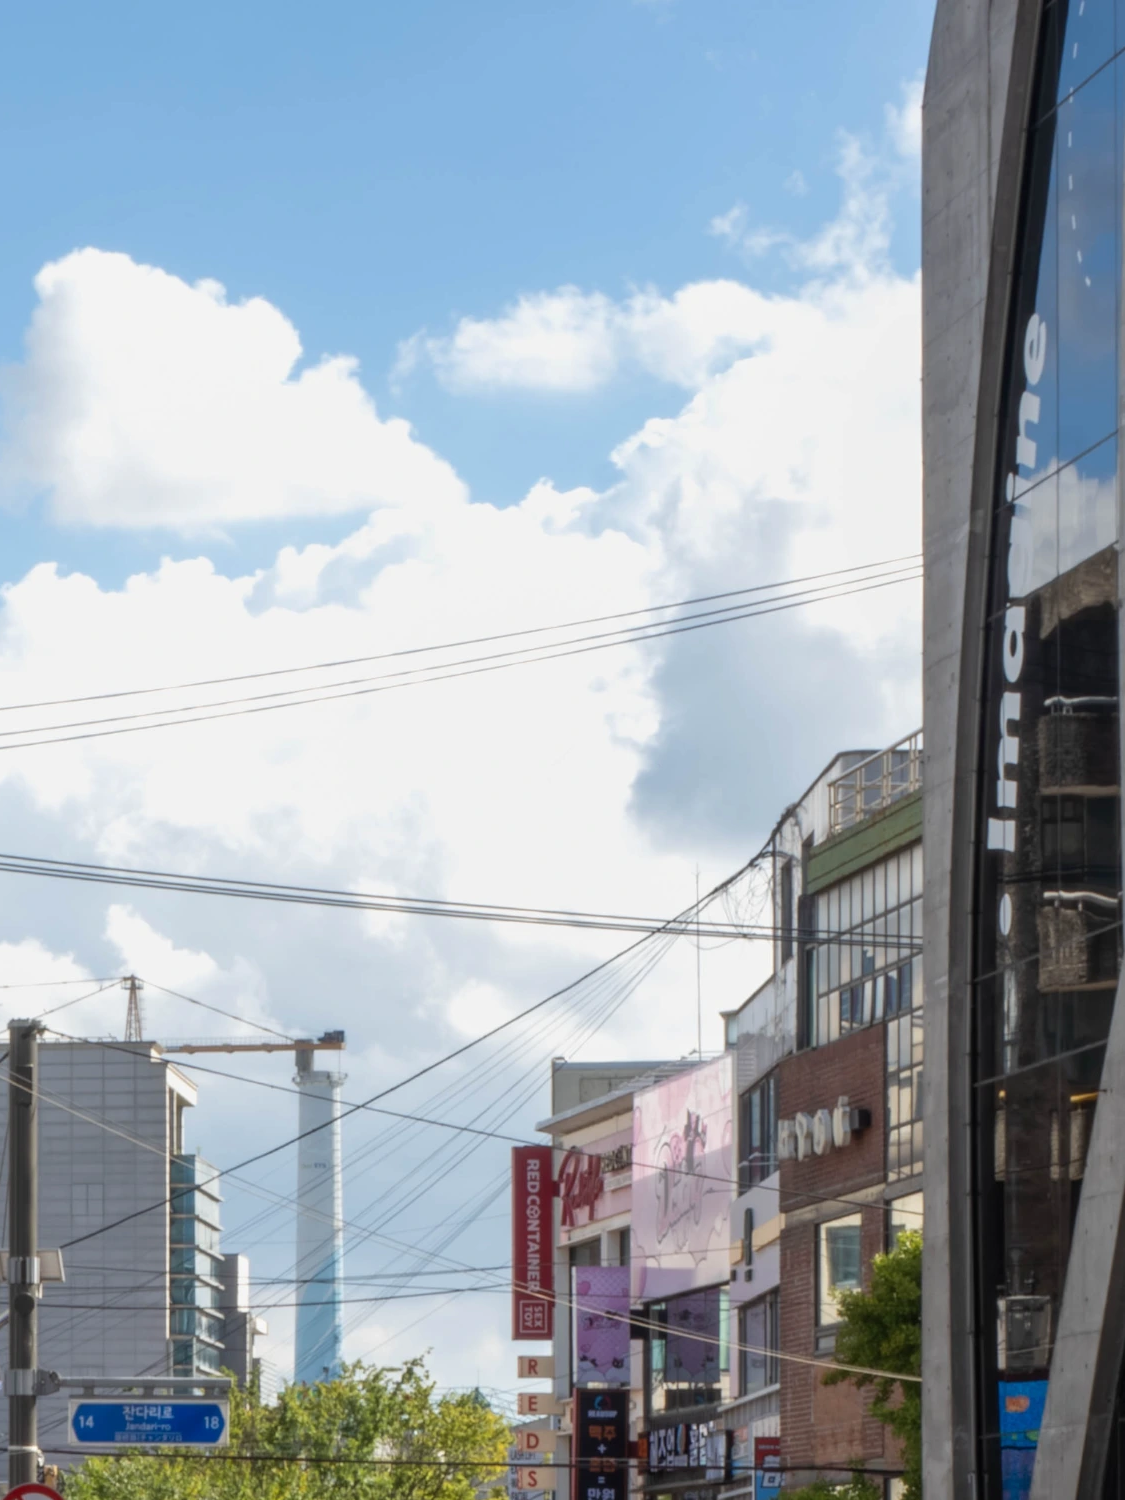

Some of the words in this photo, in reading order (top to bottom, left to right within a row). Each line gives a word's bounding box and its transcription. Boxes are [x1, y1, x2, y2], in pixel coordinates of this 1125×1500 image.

[527, 1159, 540, 1193] RED
[526, 1195, 541, 1292] CONTAINER
[525, 1306, 533, 1328] TOY
[533, 1306, 543, 1328] SEX
[79, 1415, 94, 1428] 14
[122, 1405, 174, 1421] 잔다리로
[204, 1416, 219, 1429] 18
[125, 1422, 171, 1432] Jandari-ro
